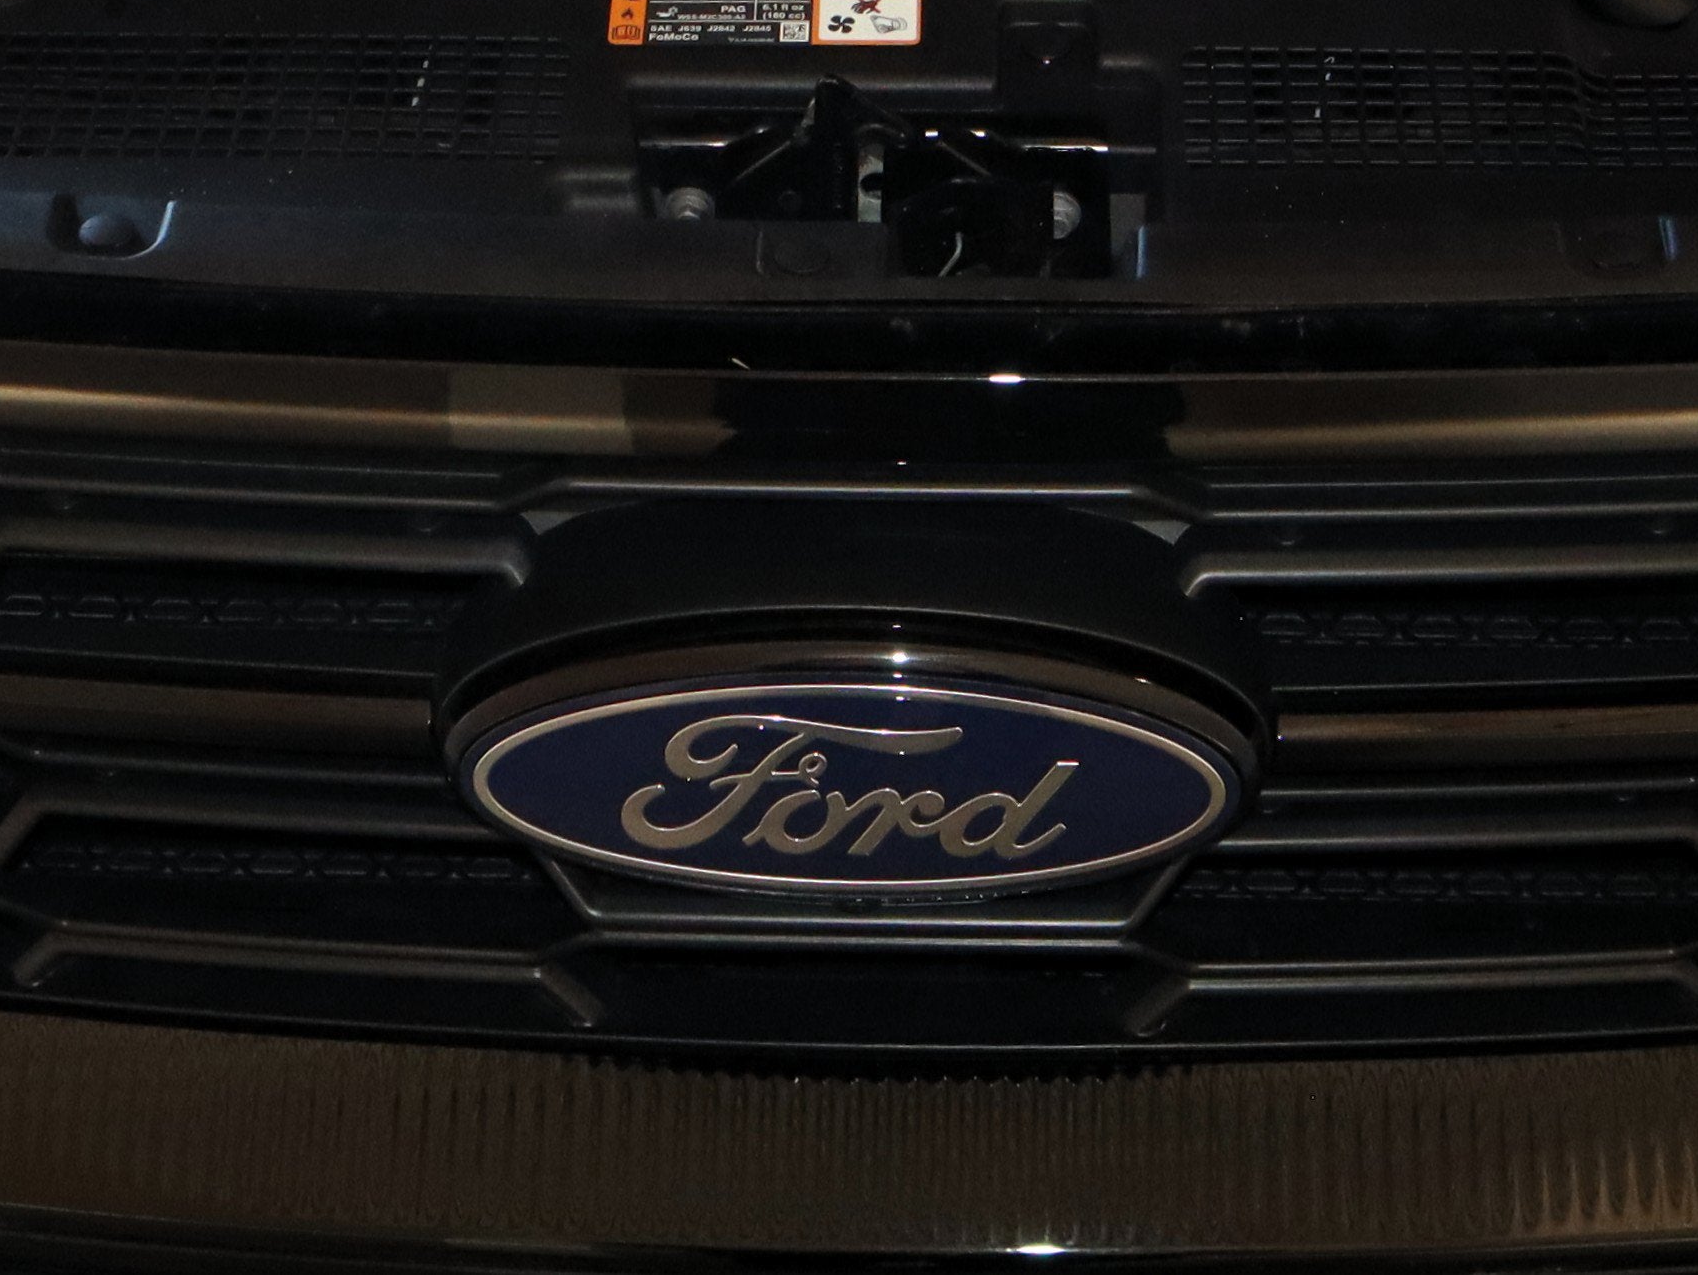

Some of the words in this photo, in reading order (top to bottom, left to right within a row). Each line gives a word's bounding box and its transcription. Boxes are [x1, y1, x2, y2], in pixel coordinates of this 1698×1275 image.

[720, 5, 747, 13] PAG
[650, 24, 673, 32] SAE
[648, 32, 700, 42] FoMoCo
[620, 712, 1081, 860] Ford
